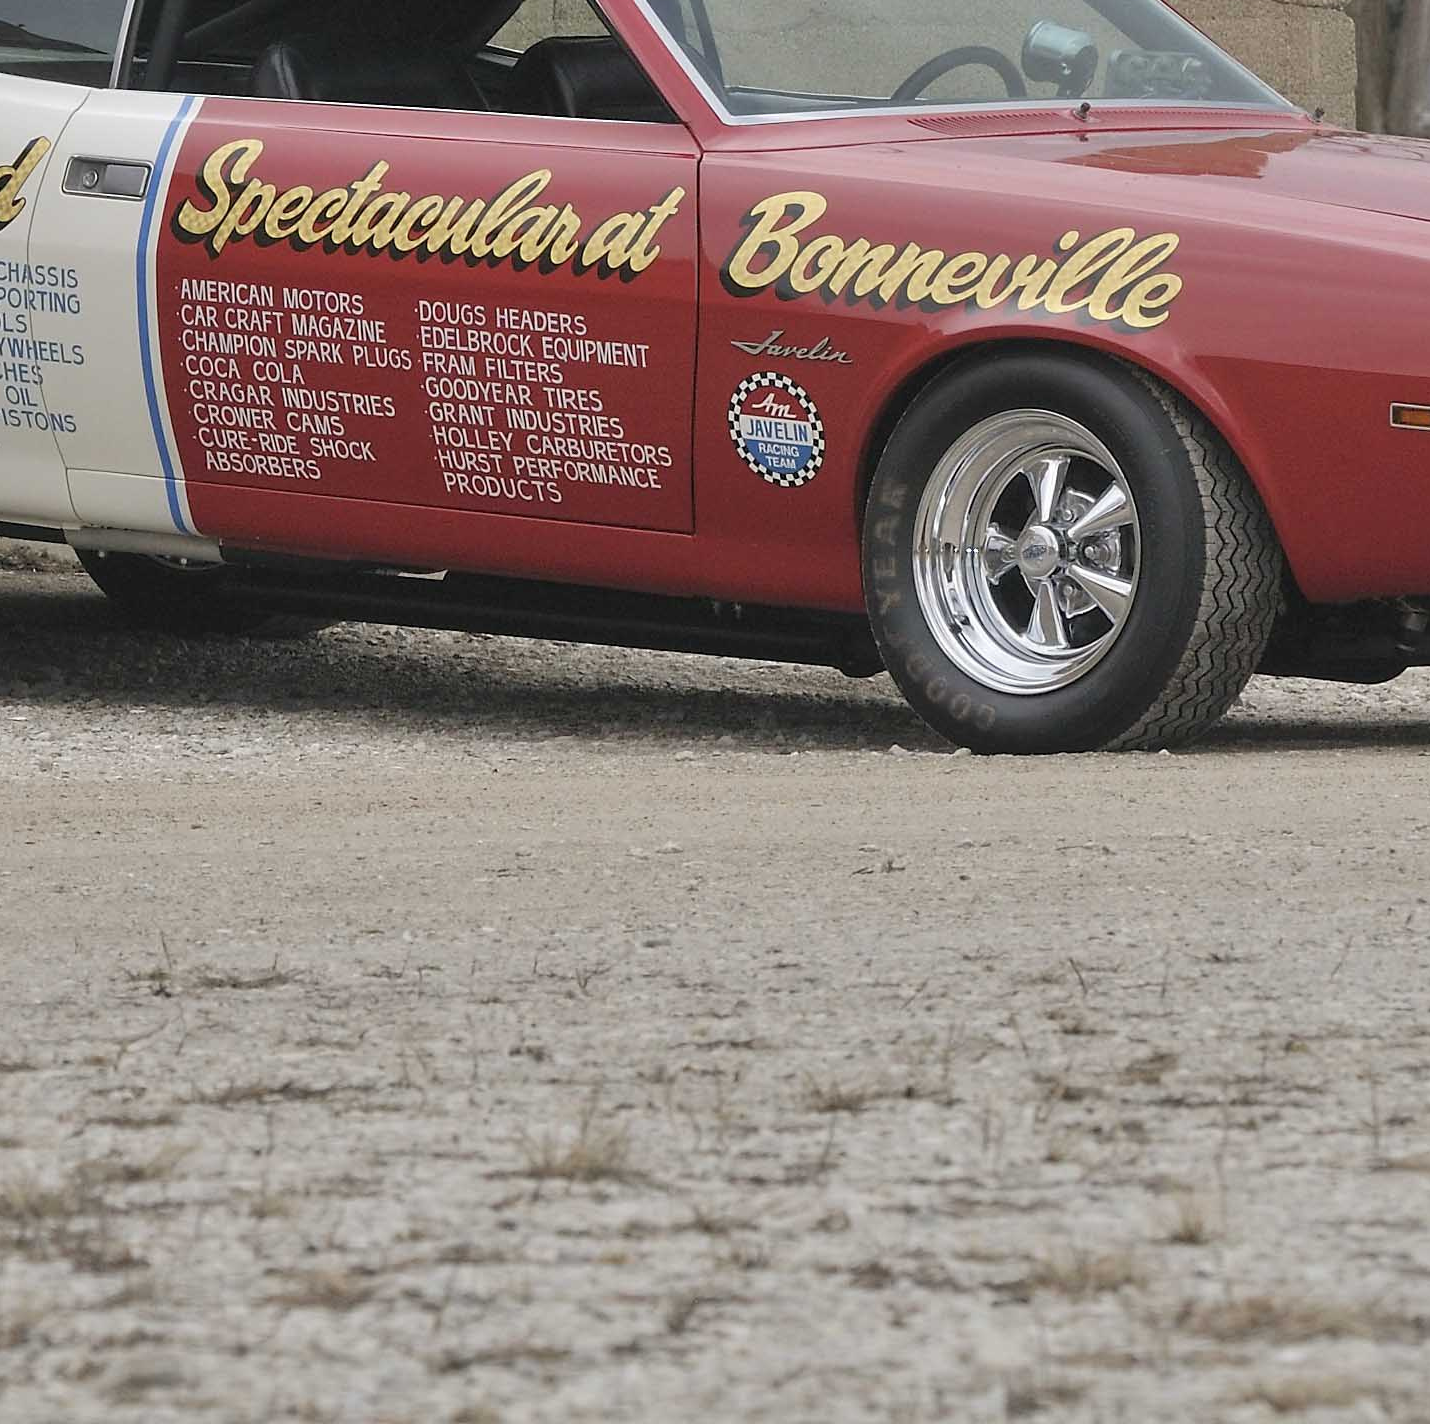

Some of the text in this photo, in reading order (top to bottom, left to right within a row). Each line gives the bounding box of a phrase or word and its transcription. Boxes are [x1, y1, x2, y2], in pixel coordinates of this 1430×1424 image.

[172, 137, 583, 272] Spectacular
[580, 186, 687, 284] at
[721, 190, 1184, 333] Bonneville
[181, 278, 364, 315] AMERICAN MOTORS
[181, 304, 386, 343] CAR CRAFT MAGAZINE
[419, 300, 586, 335] DOUGS HEADERS
[183, 329, 412, 370] CHAMPION SPARK PLUGS
[421, 326, 649, 368] EDELBROCK EQUIPMENT
[731, 329, 853, 364] Javelin
[186, 355, 305, 384] COCA COLA
[422, 352, 563, 384] FRAM FILTERS
[5, 385, 38, 407] OIL
[190, 380, 396, 417] CRAGAR INDUSTRIES
[425, 377, 603, 412] GOODYEAR TIRES
[193, 403, 345, 436] CROWER CAMS
[429, 402, 624, 438] GRANT INDUSTRIES
[747, 419, 808, 442] JAVELIN
[198, 427, 376, 461] CURE-RIDE SHOCK
[433, 425, 671, 467] HOLLEY CARBURETORS
[758, 443, 799, 457] RACING
[206, 451, 321, 480] ABSORBERS
[438, 450, 661, 489] HURST PERFORMANCE
[765, 456, 796, 469] TEAM
[443, 472, 562, 503] PRODUCTS
